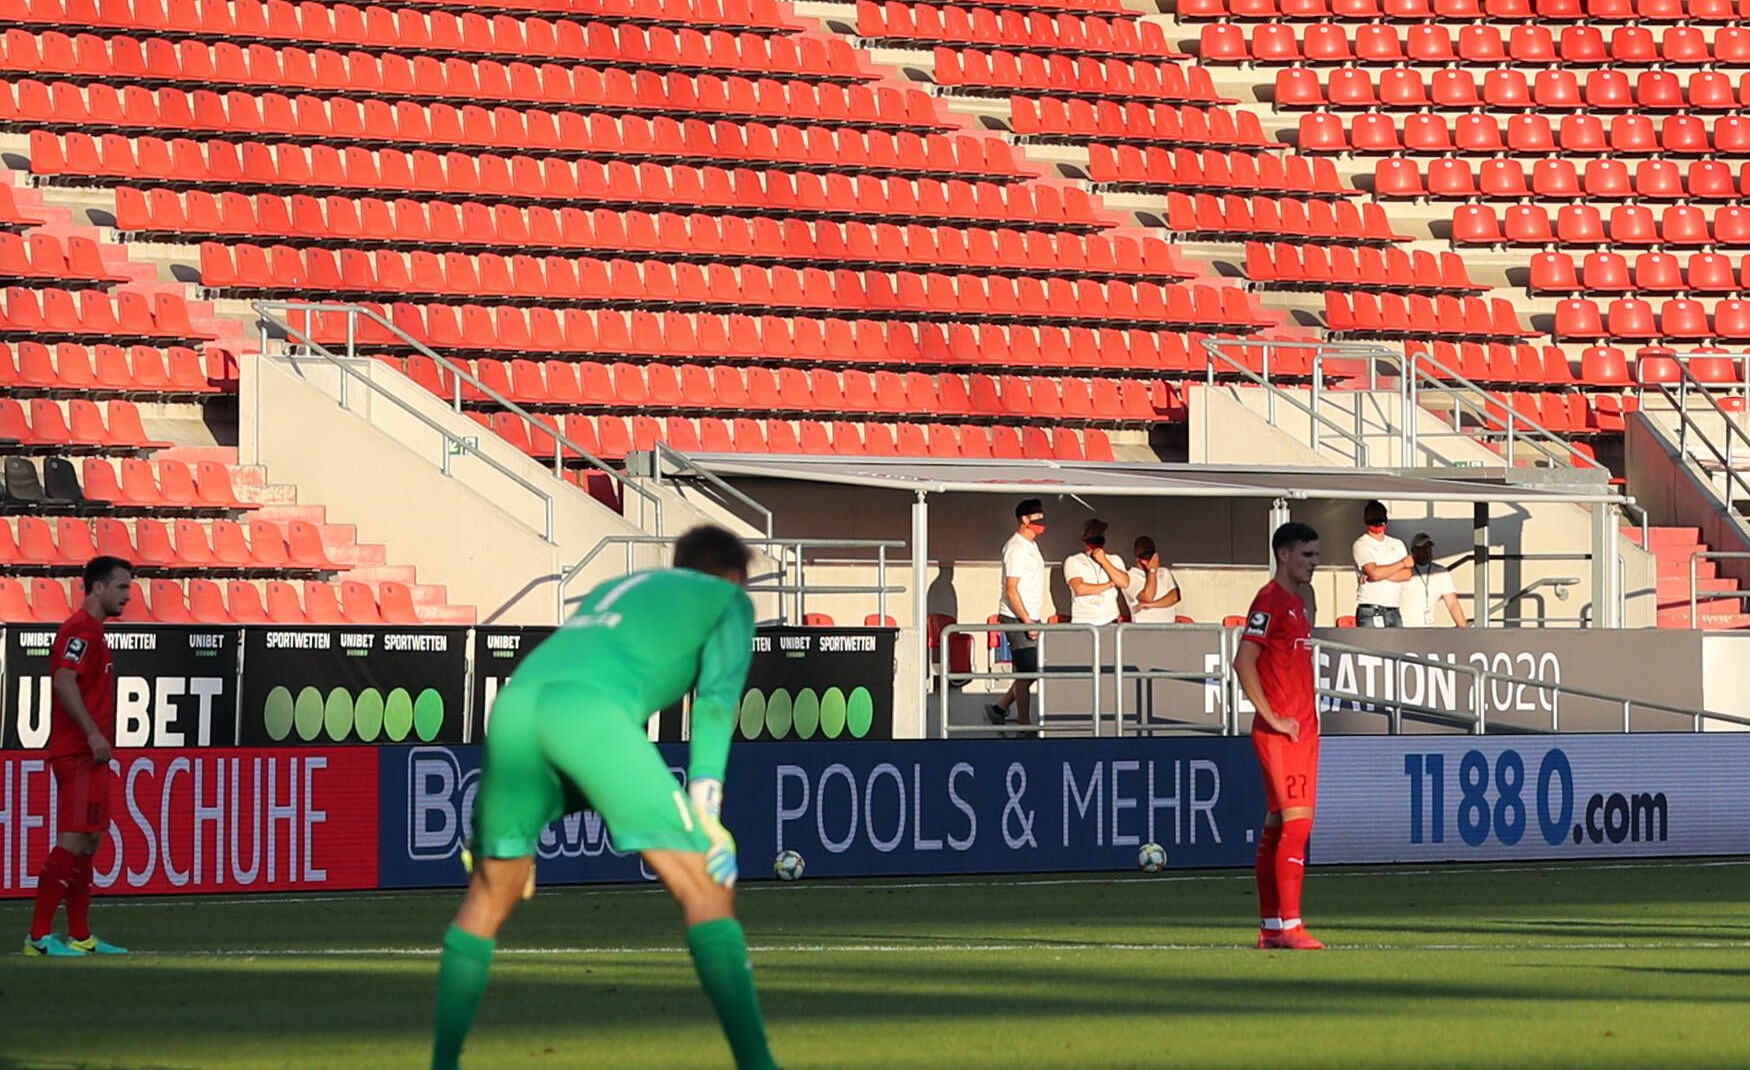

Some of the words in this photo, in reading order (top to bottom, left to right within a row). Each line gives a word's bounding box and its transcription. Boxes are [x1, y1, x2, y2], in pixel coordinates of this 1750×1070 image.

[20, 632, 57, 647] UNIBET
[103, 633, 156, 650] RTWETTEN
[189, 633, 224, 648] UNIBET
[266, 632, 330, 649] SPORTWETTEN
[340, 633, 374, 648] UNIBET
[384, 634, 447, 651] SPORTWETTEN
[487, 634, 520, 649] UNIBET
[780, 636, 811, 650] UNIBET
[819, 636, 876, 652] SPORTWETTEN
[1469, 651, 1560, 712] 2020
[17, 676, 223, 749] UBET
[1285, 773, 1308, 800] 27
[776, 761, 978, 854] POOLS
[1001, 761, 1038, 850] &
[1062, 759, 1222, 847] MEHR
